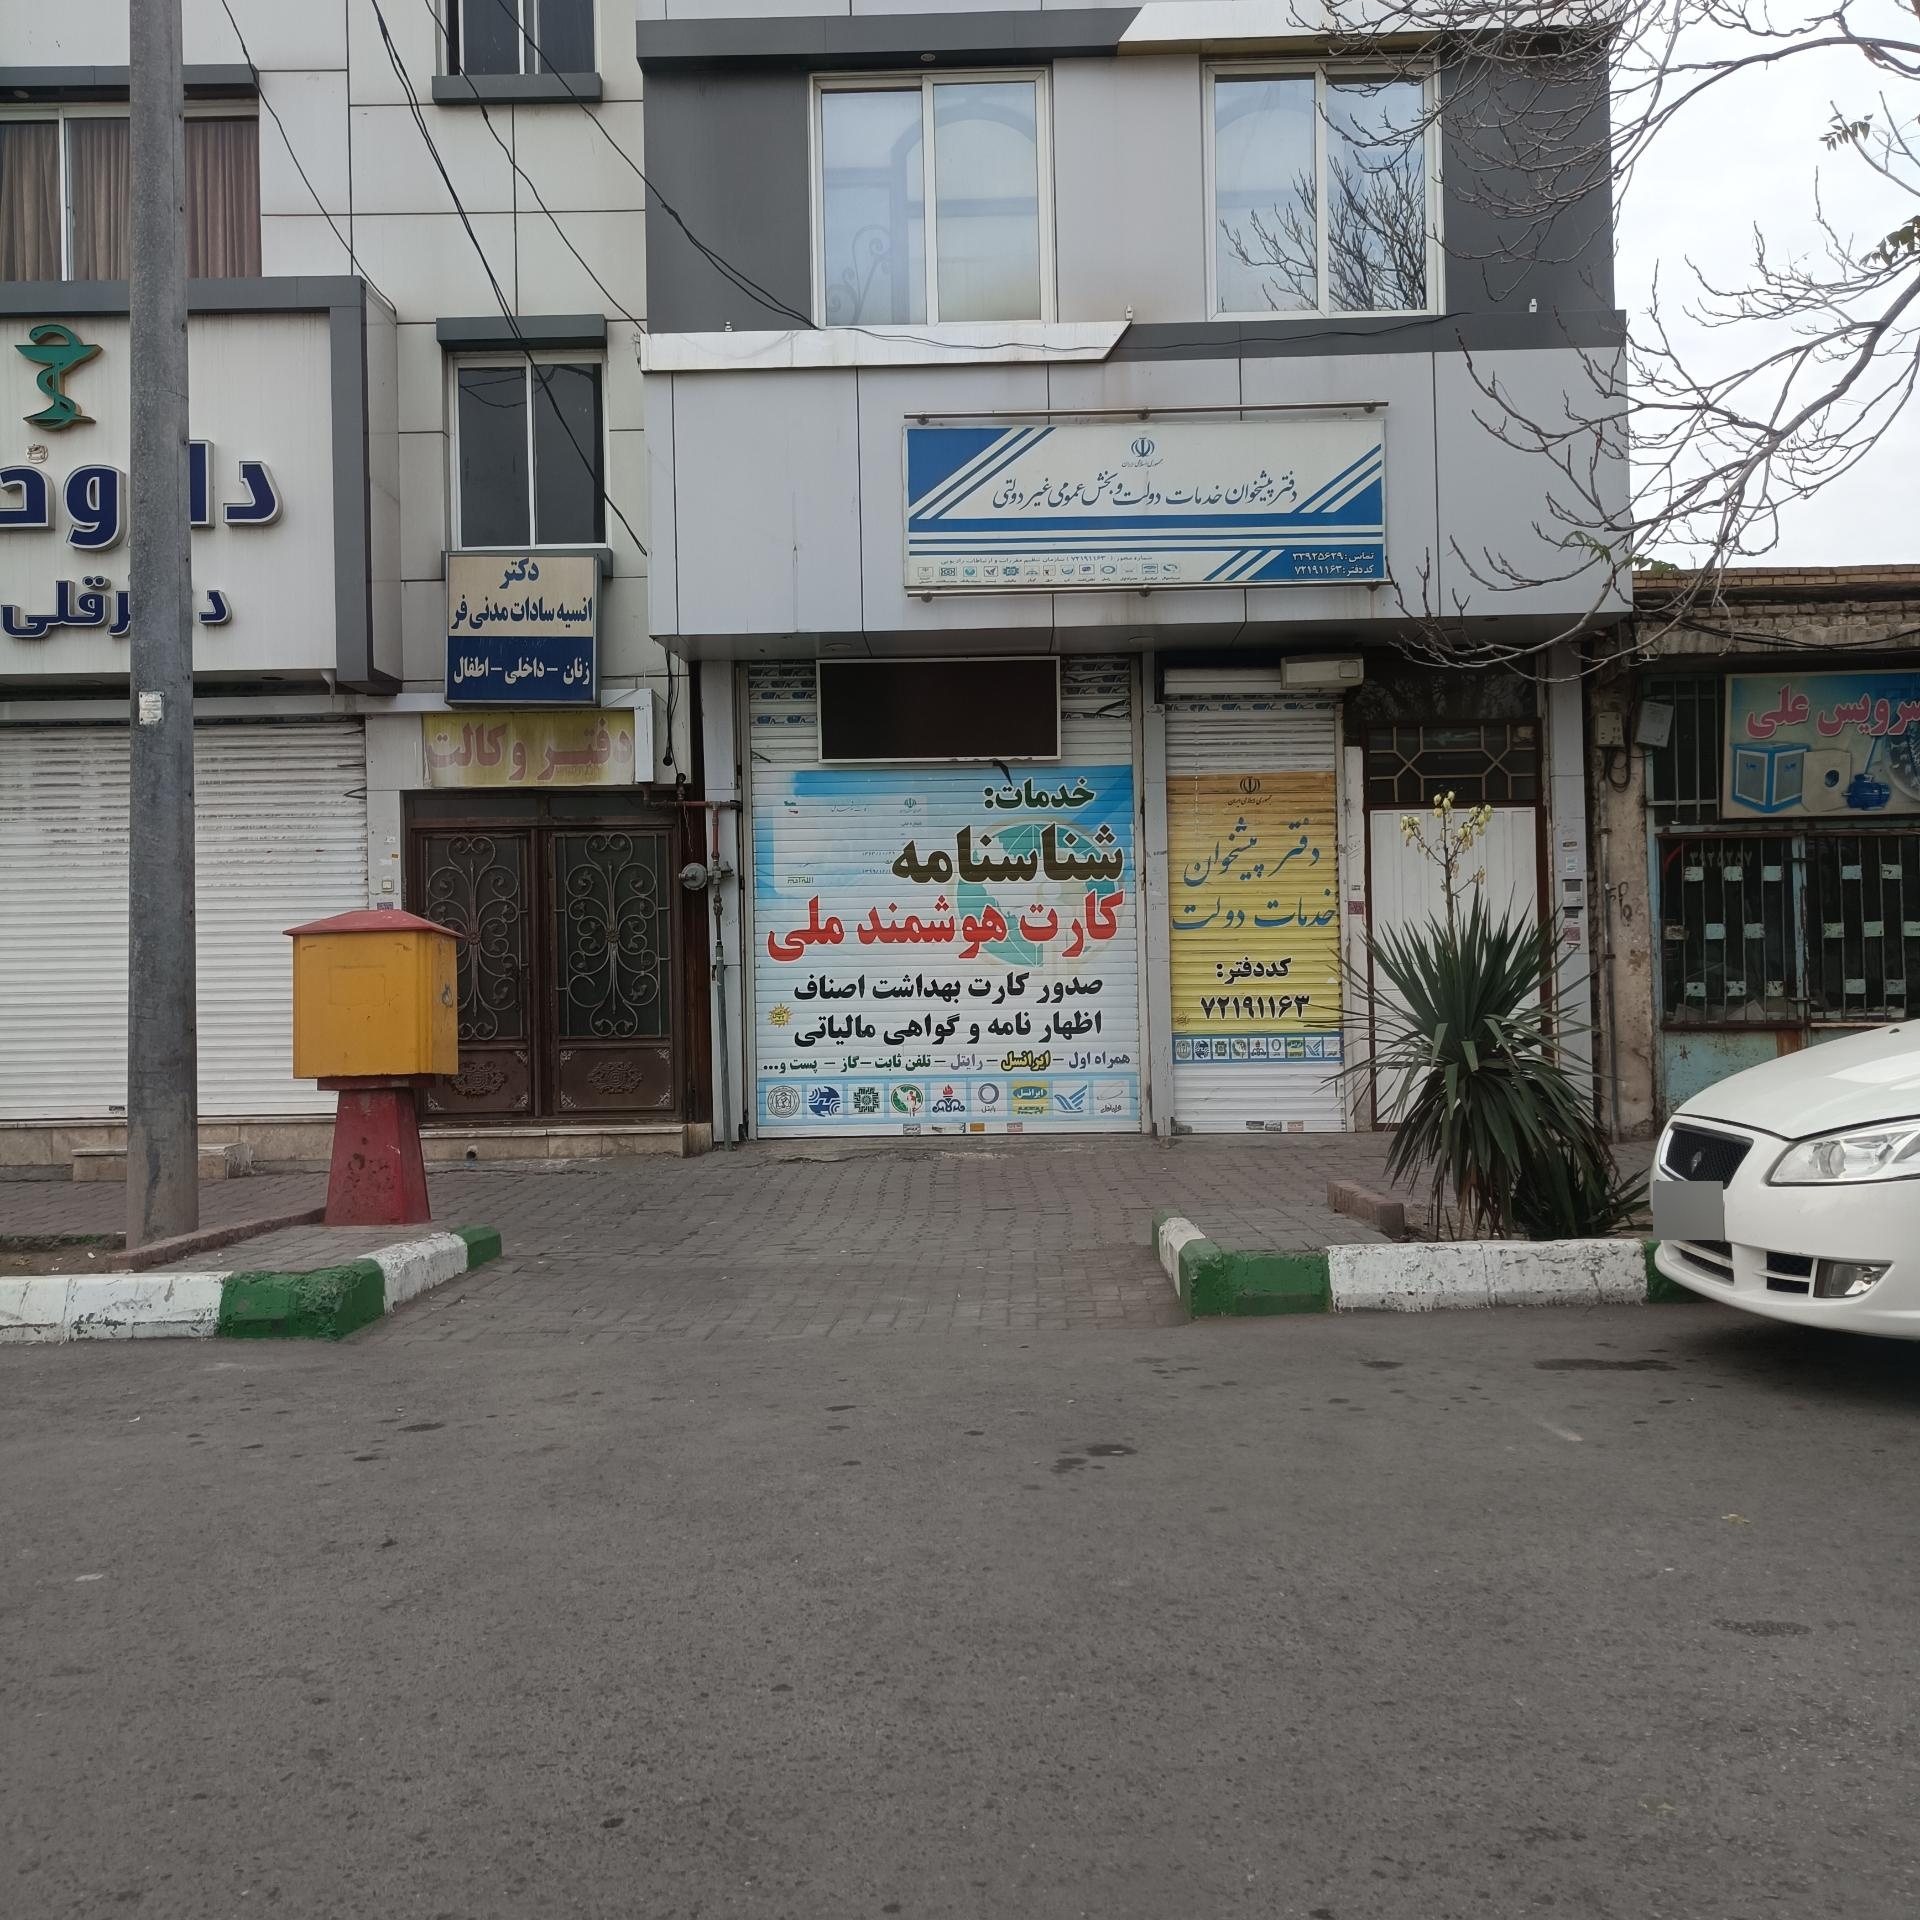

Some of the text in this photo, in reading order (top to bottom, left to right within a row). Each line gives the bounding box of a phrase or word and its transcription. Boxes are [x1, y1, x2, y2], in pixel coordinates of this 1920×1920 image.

[992, 479, 1024, 509] دولتی
[1020, 477, 1050, 511] غیر
[1048, 483, 1086, 509] عمومی
[1082, 471, 1118, 506] بخش
[1113, 480, 1161, 506] دولت
[1166, 485, 1223, 505] خدمات
[1225, 470, 1274, 505] پیشخوان
[1267, 471, 1298, 506] دفتر
[499, 558, 540, 589] دکتر
[451, 594, 593, 630] انسیه سادات مدنی فر
[453, 656, 489, 684] اطفال
[504, 657, 545, 684] داخلی
[563, 657, 590, 685] زنان
[1747, 684, 1810, 739] علی
[426, 717, 634, 782] دفتر وکالت
[983, 777, 1096, 810] خدمات:
[891, 822, 1125, 884] شناسنامه
[1183, 815, 1321, 888] دفتر پیشخوان
[1171, 887, 1337, 932] خدمات دولت
[767, 889, 1124, 962] کارت هوشمند ملی
[794, 972, 1103, 1004] صدور کارت بهداشت اصناف
[1200, 995, 1310, 1020] ۷۲۱۹۱۱۶۳
[794, 1013, 876, 1047] مالیاتی
[883, 1013, 961, 1045] گواهی
[967, 1023, 981, 1044] و
[987, 1014, 1032, 1037] نامه
[1038, 1009, 1102, 1043] اظهار
[789, 1058, 818, 1073] پست
[840, 1055, 860, 1073] گاز
[875, 1053, 902, 1072] ثابت
[905, 1054, 932, 1071] تلفن
[950, 1053, 984, 1071] رایتل
[1000, 1049, 1051, 1072] ایرانسل
[1068, 1051, 1092, 1070] اول
[1094, 1051, 1131, 1069] همراه
[1016, 1088, 1044, 1100] ایرانسل
